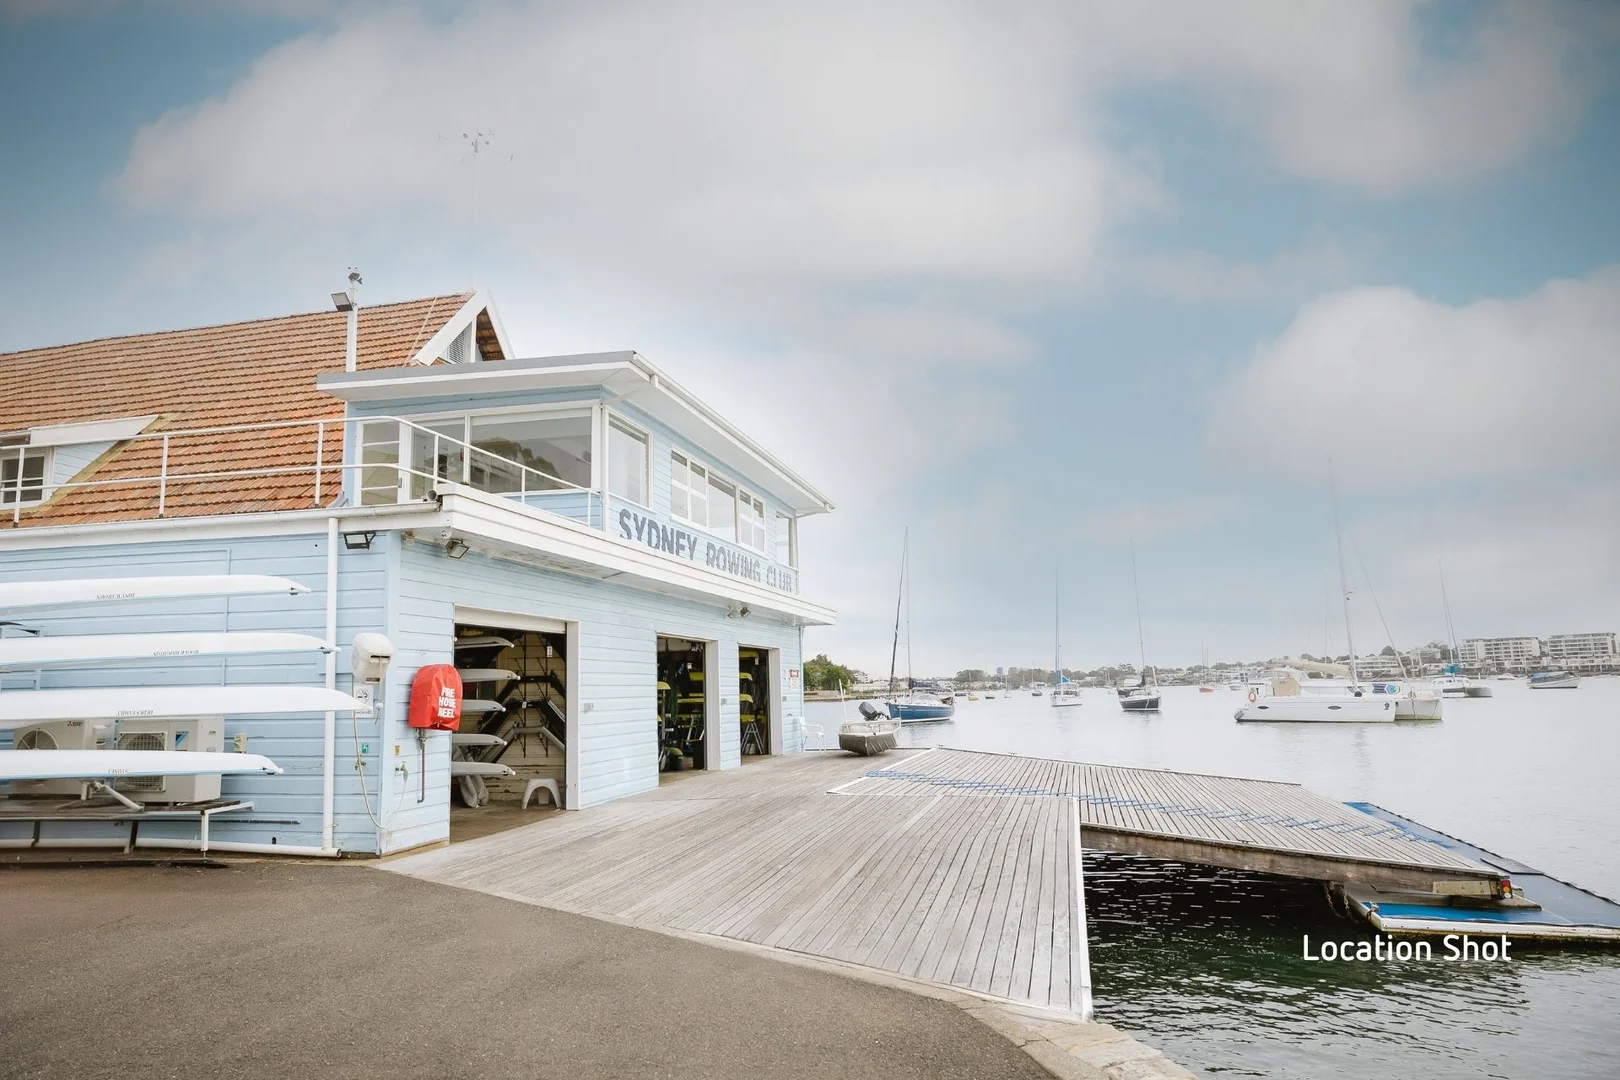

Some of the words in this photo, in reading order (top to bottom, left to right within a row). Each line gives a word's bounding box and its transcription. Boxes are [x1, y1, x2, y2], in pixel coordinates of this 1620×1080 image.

[619, 508, 698, 561] SYDNEY
[706, 541, 762, 583] ROWING
[766, 565, 793, 592] CLUB
[438, 696, 456, 709] HOSE
[437, 708, 455, 718] REEL
